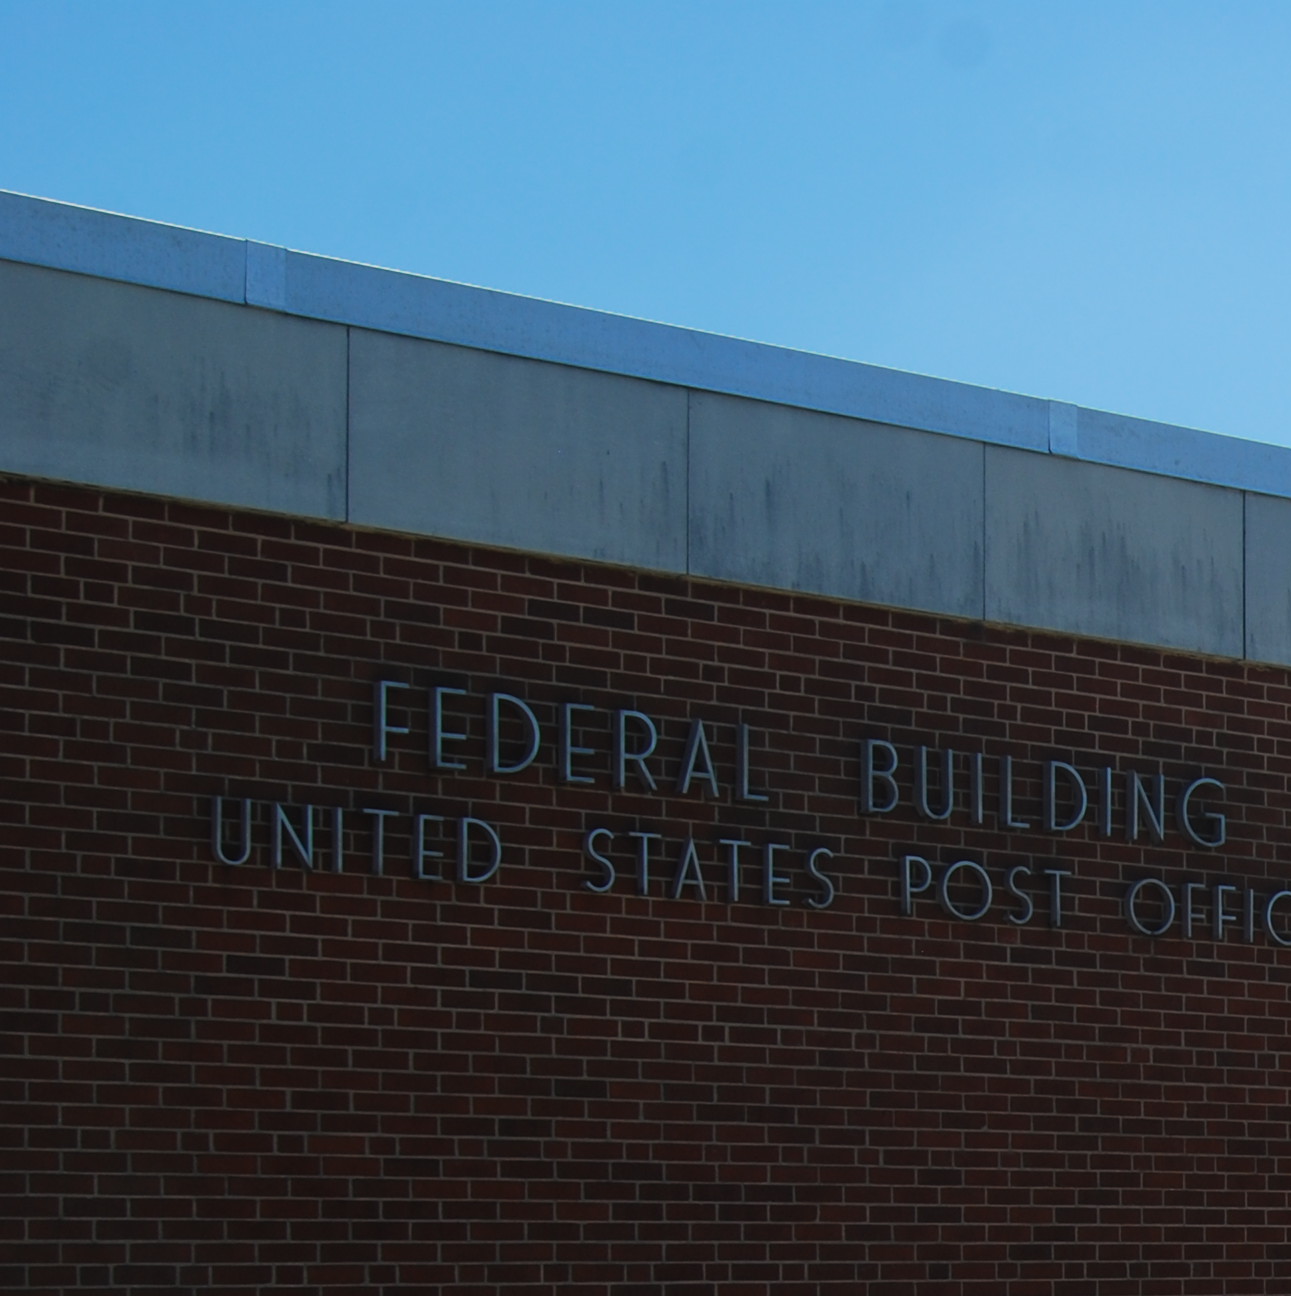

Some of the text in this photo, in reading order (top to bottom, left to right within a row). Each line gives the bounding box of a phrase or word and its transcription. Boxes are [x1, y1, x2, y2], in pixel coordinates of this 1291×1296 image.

[373, 680, 1227, 847] FEDERAL BUILDING
[211, 797, 501, 884] UNITED
[582, 828, 835, 909] STATES
[901, 855, 1072, 928] POST
